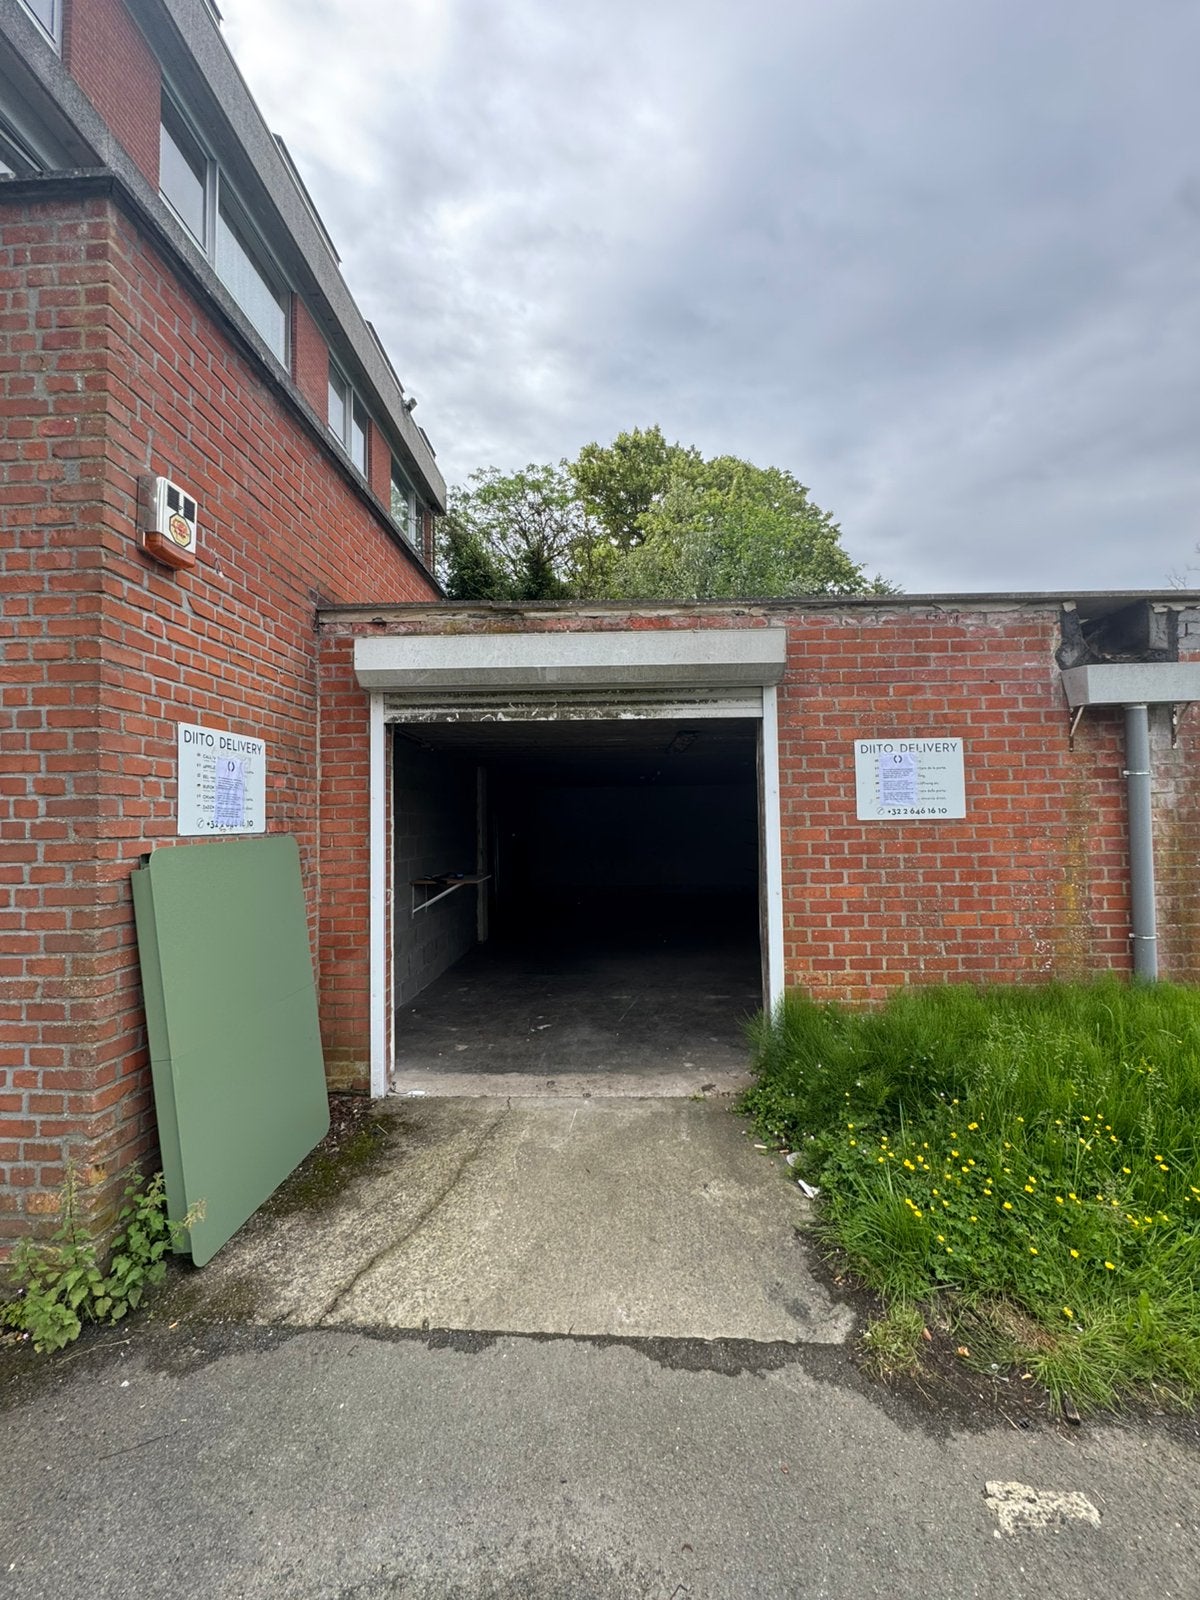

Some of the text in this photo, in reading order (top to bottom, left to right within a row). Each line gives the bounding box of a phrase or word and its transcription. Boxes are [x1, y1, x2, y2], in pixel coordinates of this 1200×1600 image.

[184, 730, 263, 755] DIITO DELIVERY
[860, 743, 958, 754] DIITO DELIVERY
[887, 808, 901, 816] +32
[909, 807, 926, 815] 646
